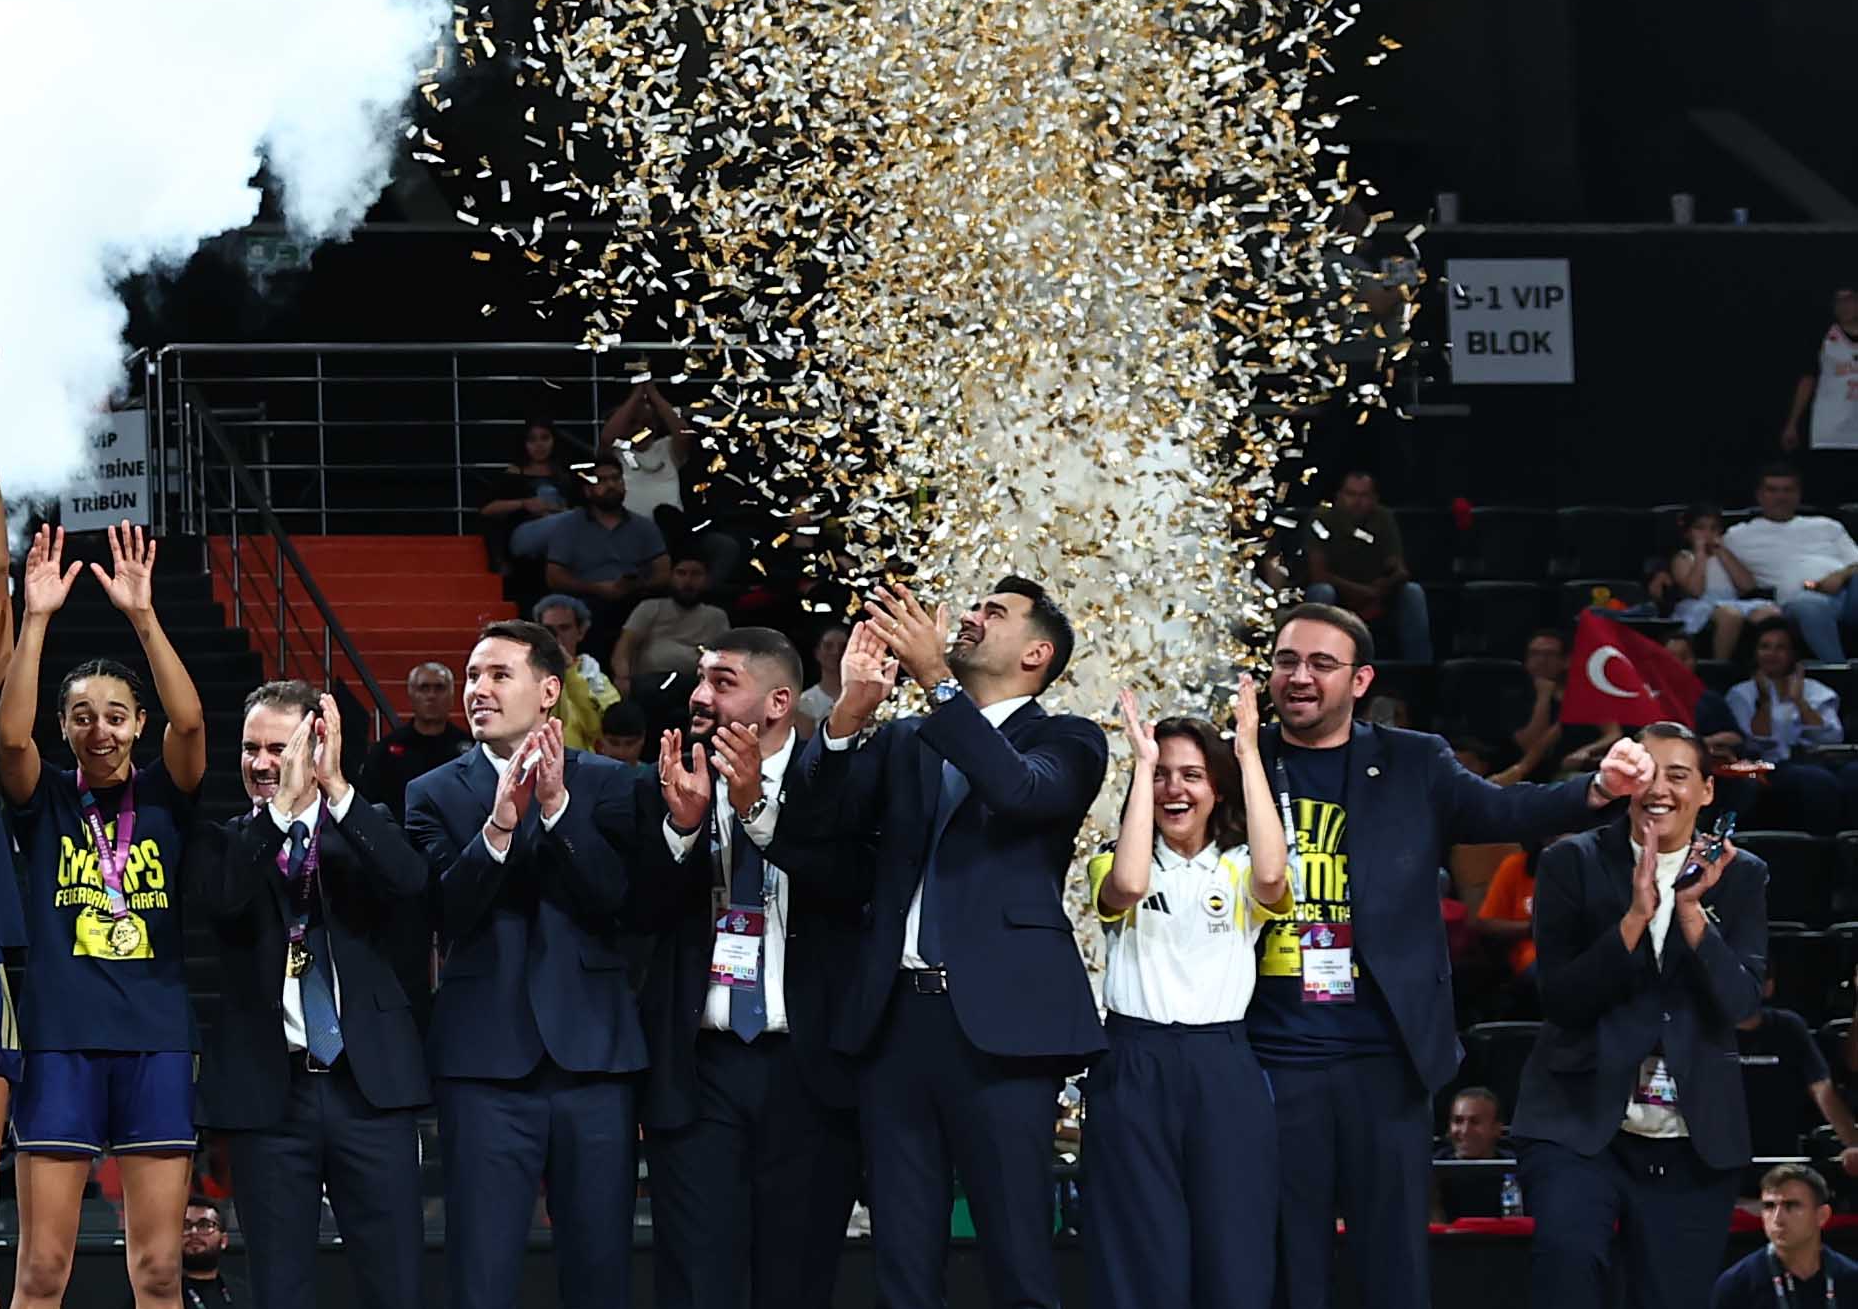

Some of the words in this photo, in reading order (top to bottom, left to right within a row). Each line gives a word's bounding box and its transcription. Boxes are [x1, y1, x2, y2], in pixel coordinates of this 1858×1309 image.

[1454, 286, 1502, 310] S-1
[1513, 286, 1564, 309] VIP
[1468, 331, 1552, 354] BLOK
[72, 491, 137, 513] TRİBÜN
